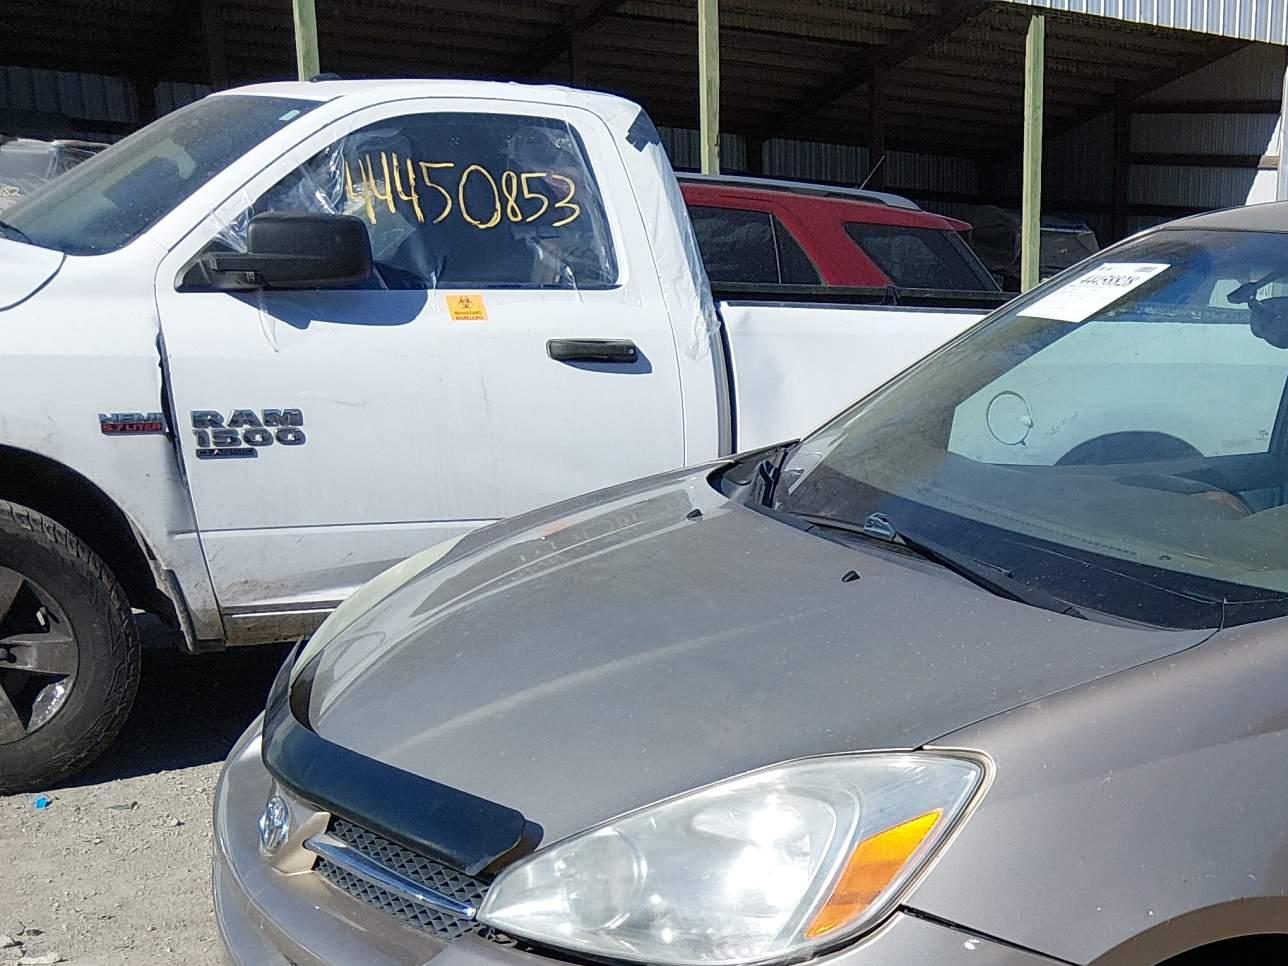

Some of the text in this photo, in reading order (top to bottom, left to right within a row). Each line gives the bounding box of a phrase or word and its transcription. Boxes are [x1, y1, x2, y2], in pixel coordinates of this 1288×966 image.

[344, 151, 580, 229] 44450853
[190, 408, 304, 428] RAM
[192, 427, 307, 447] 1500
